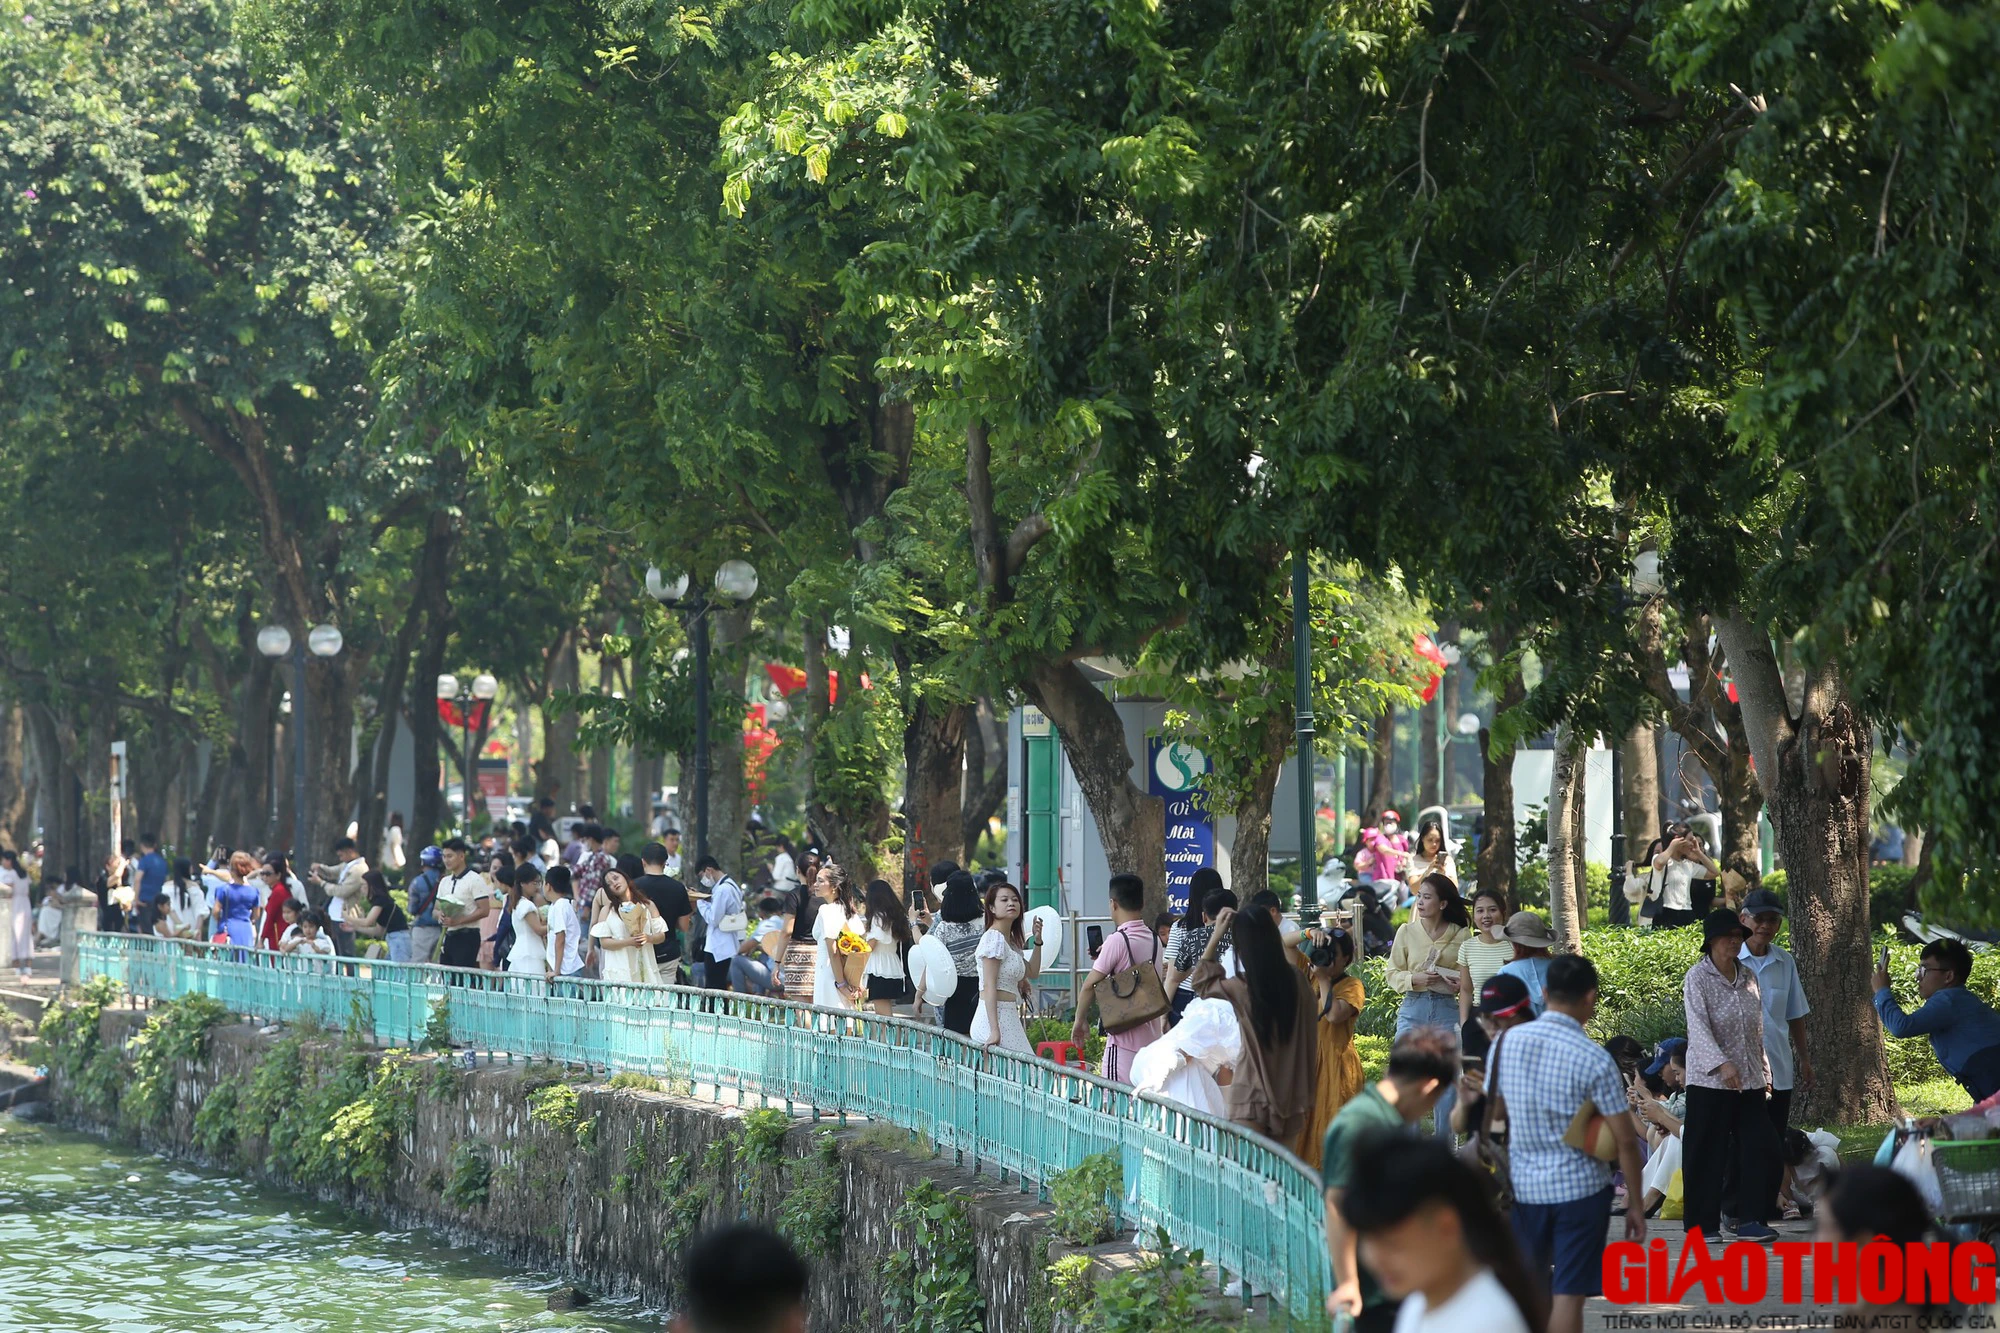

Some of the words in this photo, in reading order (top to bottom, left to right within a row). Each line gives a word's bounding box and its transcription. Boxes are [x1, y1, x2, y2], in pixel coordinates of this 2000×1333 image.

[1169, 800, 1190, 816] Vì
[1166, 825, 1196, 839] Môi
[1164, 848, 1204, 866] rường
[1165, 870, 1194, 885] Xan
[1168, 894, 1190, 911] Sạc
